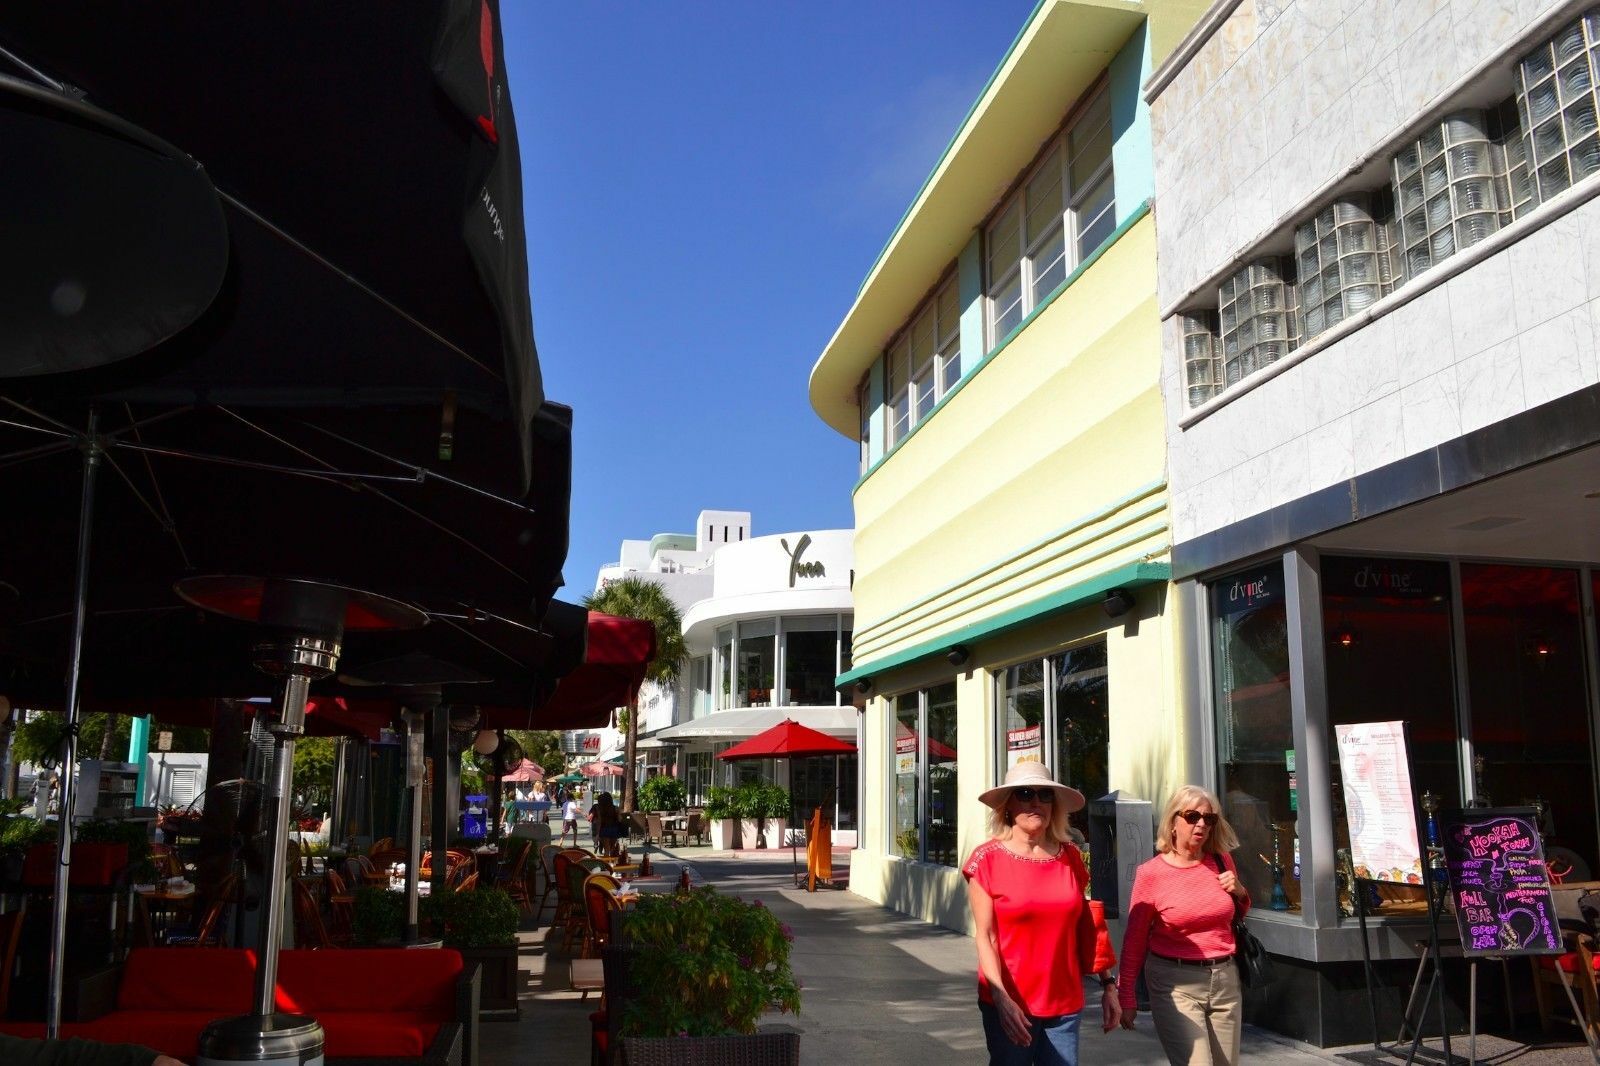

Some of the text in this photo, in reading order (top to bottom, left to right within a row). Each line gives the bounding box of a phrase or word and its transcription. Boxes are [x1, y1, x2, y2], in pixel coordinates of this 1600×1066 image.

[1470, 823, 1520, 857] HOOKAH
[1501, 837, 1530, 852] TOWN
[1460, 890, 1488, 908] FULL
[1466, 907, 1494, 924] BAR
[1470, 925, 1498, 936] OPEN
